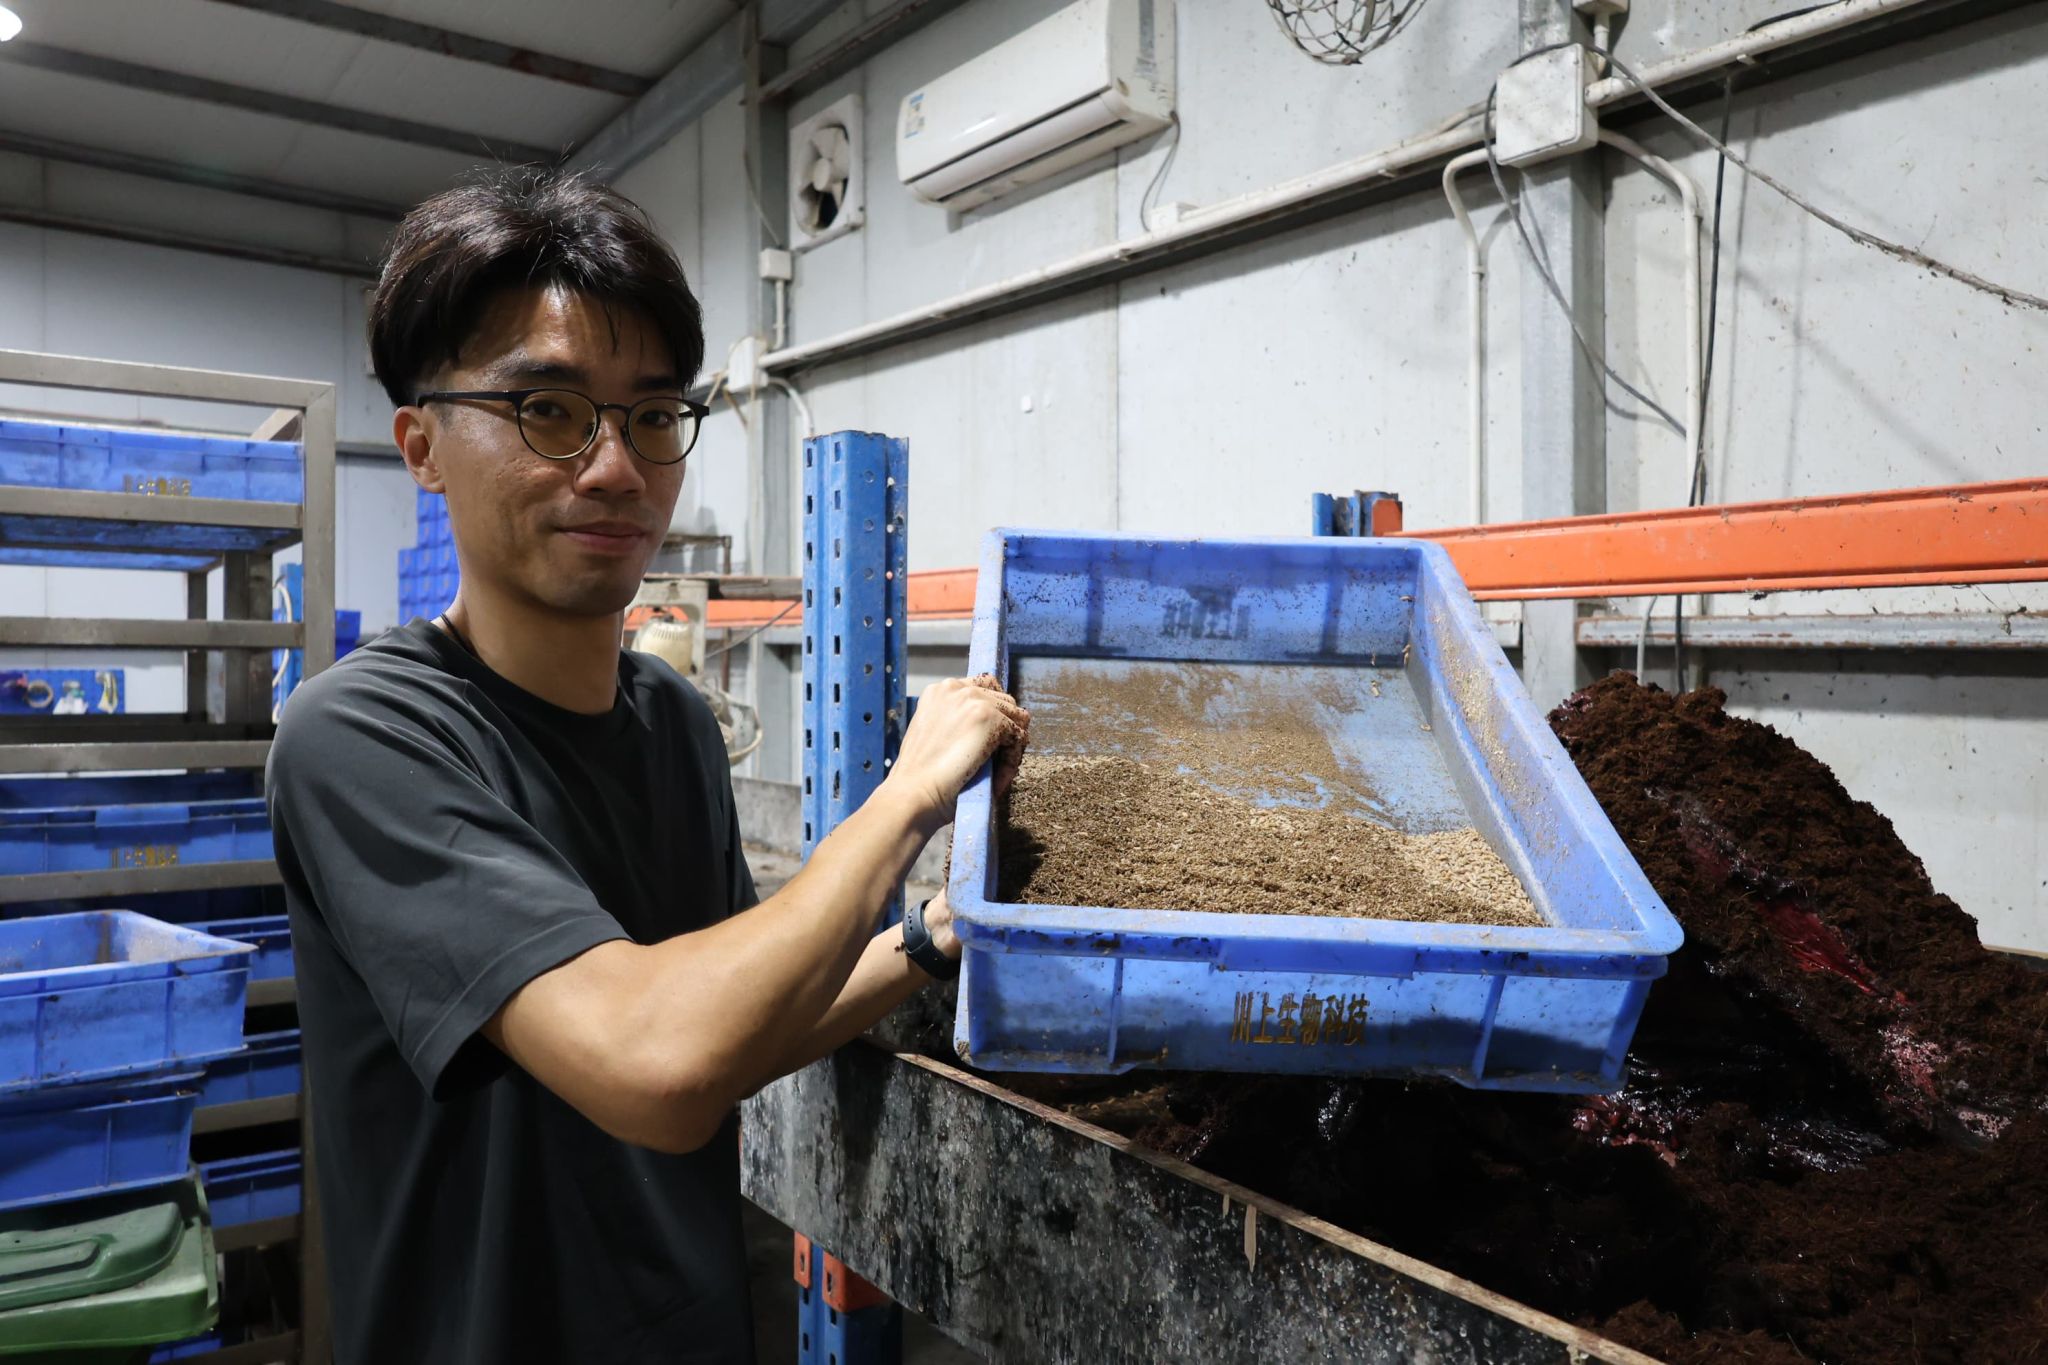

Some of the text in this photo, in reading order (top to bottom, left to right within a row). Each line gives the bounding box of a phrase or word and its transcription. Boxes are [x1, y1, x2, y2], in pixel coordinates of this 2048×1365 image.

[1231, 991, 1369, 1046] 川上生物科技
